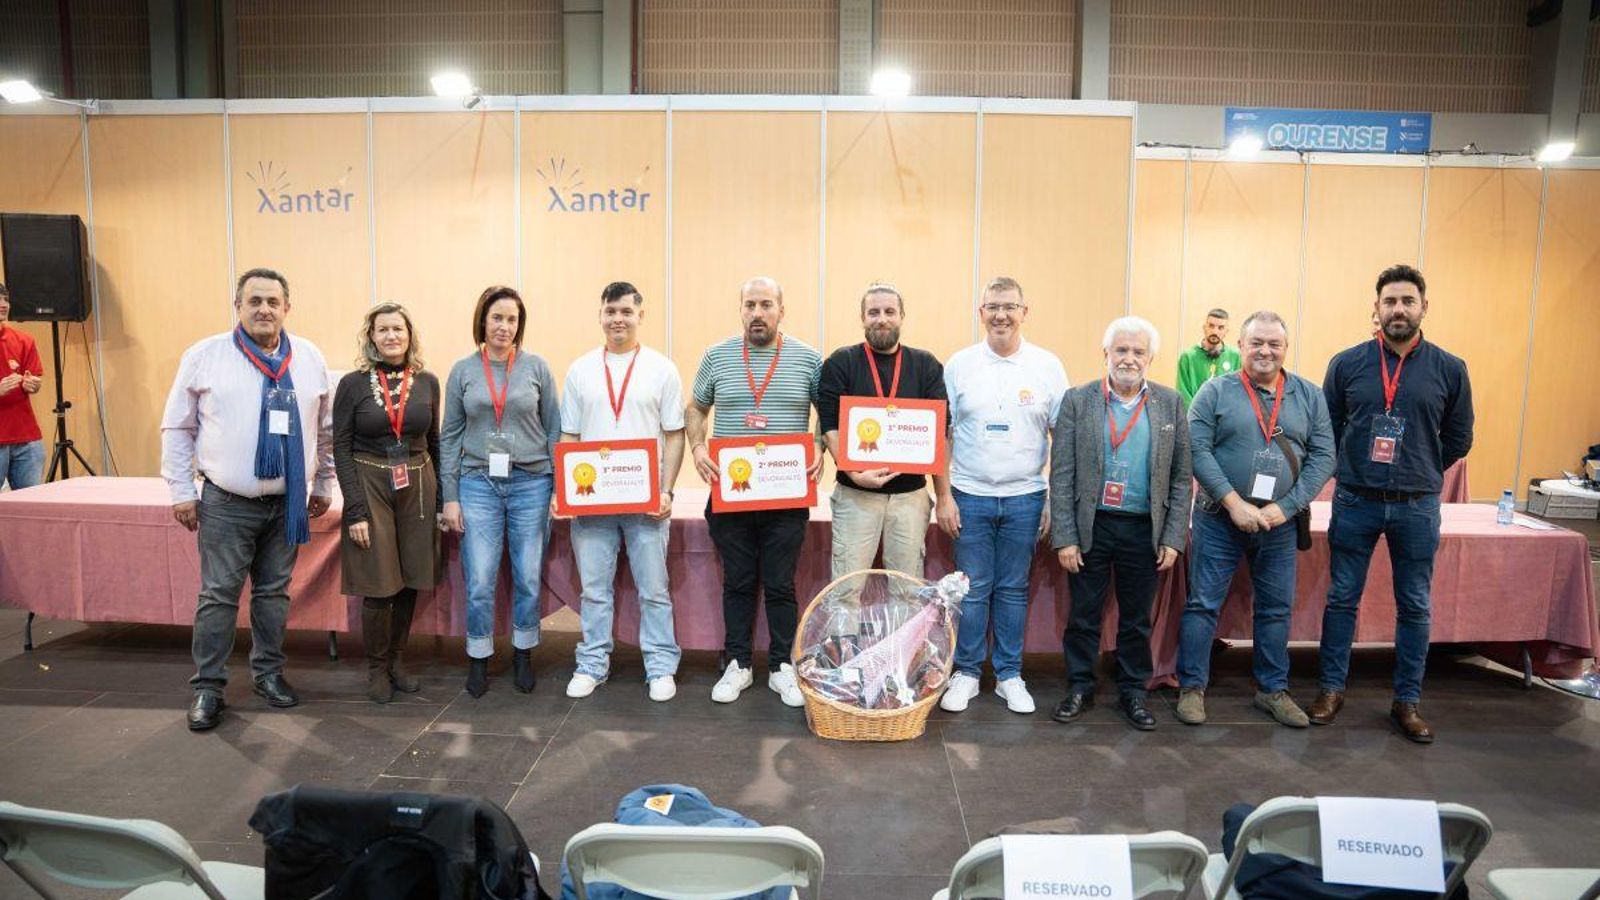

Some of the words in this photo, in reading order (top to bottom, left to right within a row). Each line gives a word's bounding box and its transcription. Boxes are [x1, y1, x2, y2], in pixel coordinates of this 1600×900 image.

[1267, 123, 1388, 150] OURENSE
[897, 424, 929, 432] PREMIO
[611, 465, 642, 473] PREMIO
[767, 459, 799, 468] PREMIO
[1337, 839, 1425, 858] RESERVADO
[1022, 880, 1113, 897] RESERVADO
